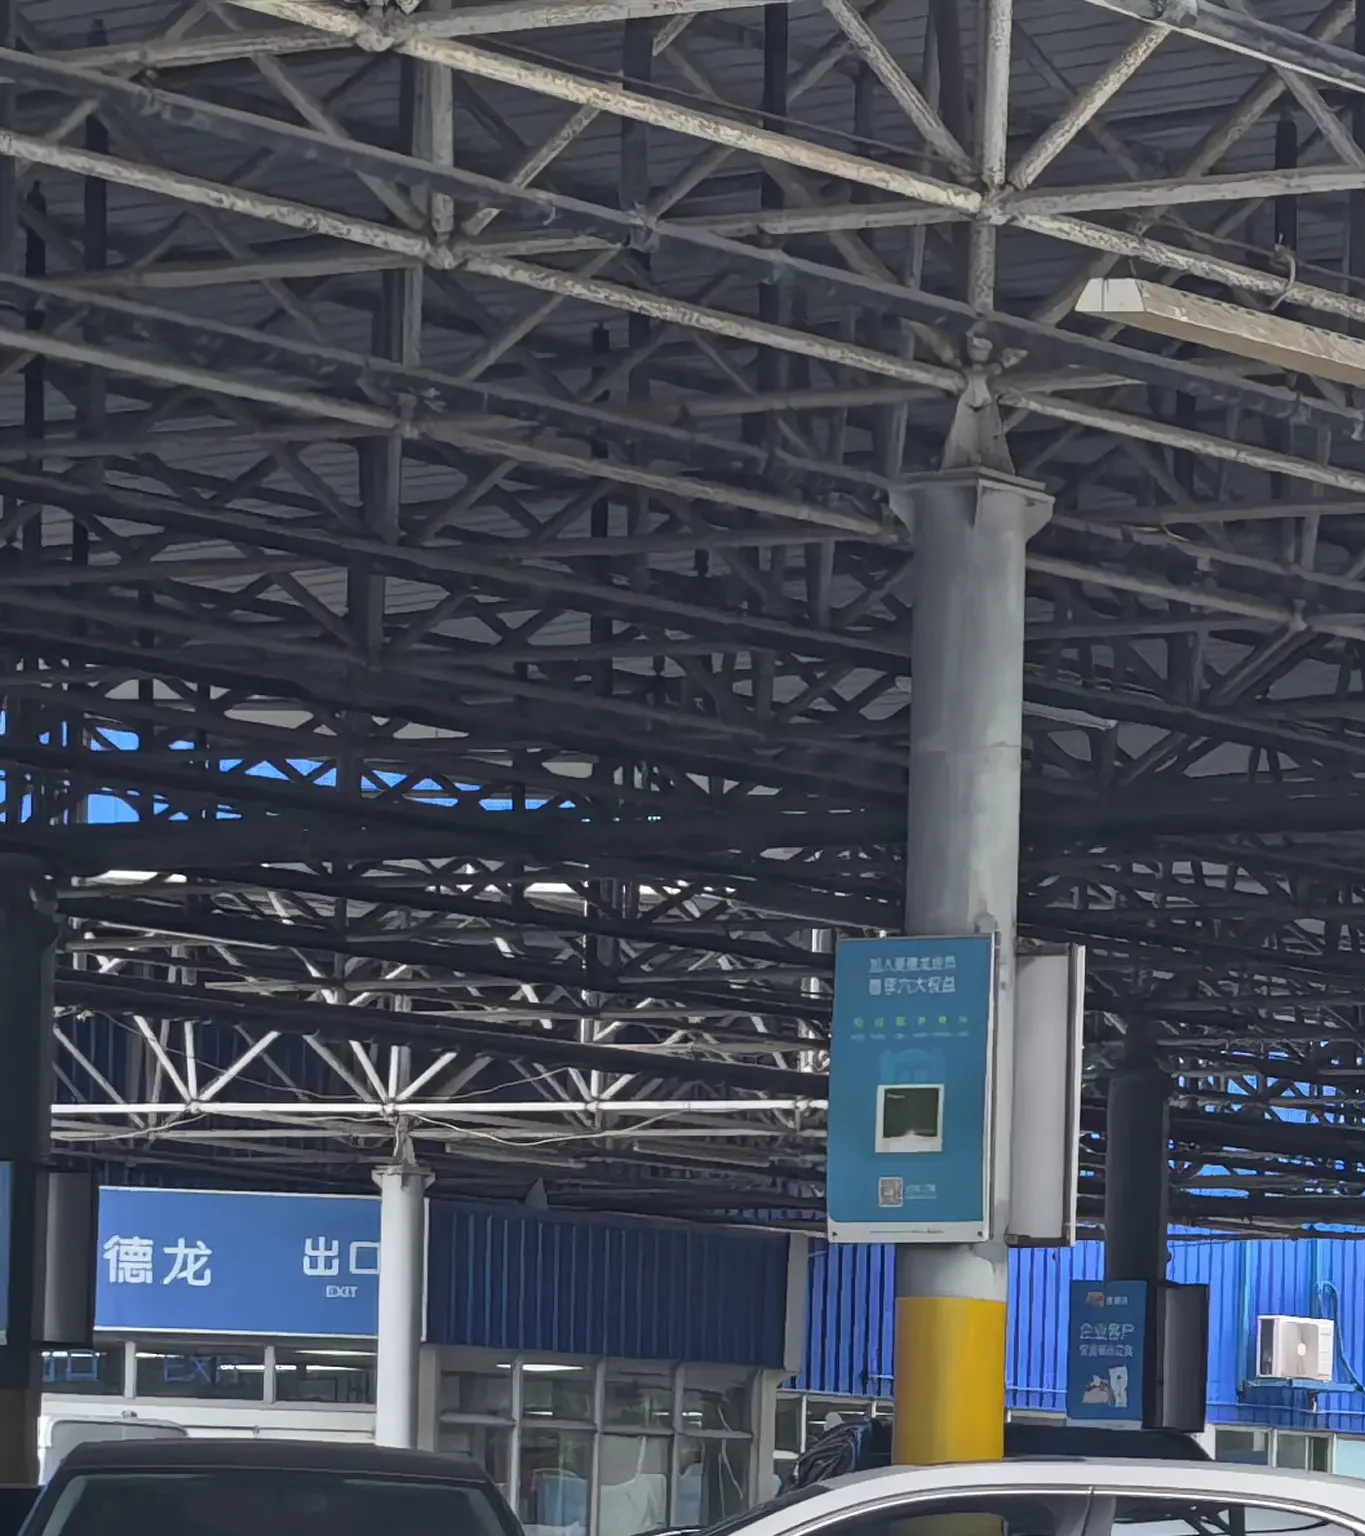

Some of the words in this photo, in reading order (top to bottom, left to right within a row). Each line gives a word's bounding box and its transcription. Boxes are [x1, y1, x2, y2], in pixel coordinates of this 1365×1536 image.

[102, 1235, 213, 1287] 德龙
[302, 1236, 381, 1277] 出口
[326, 1285, 359, 1298] EXIT
